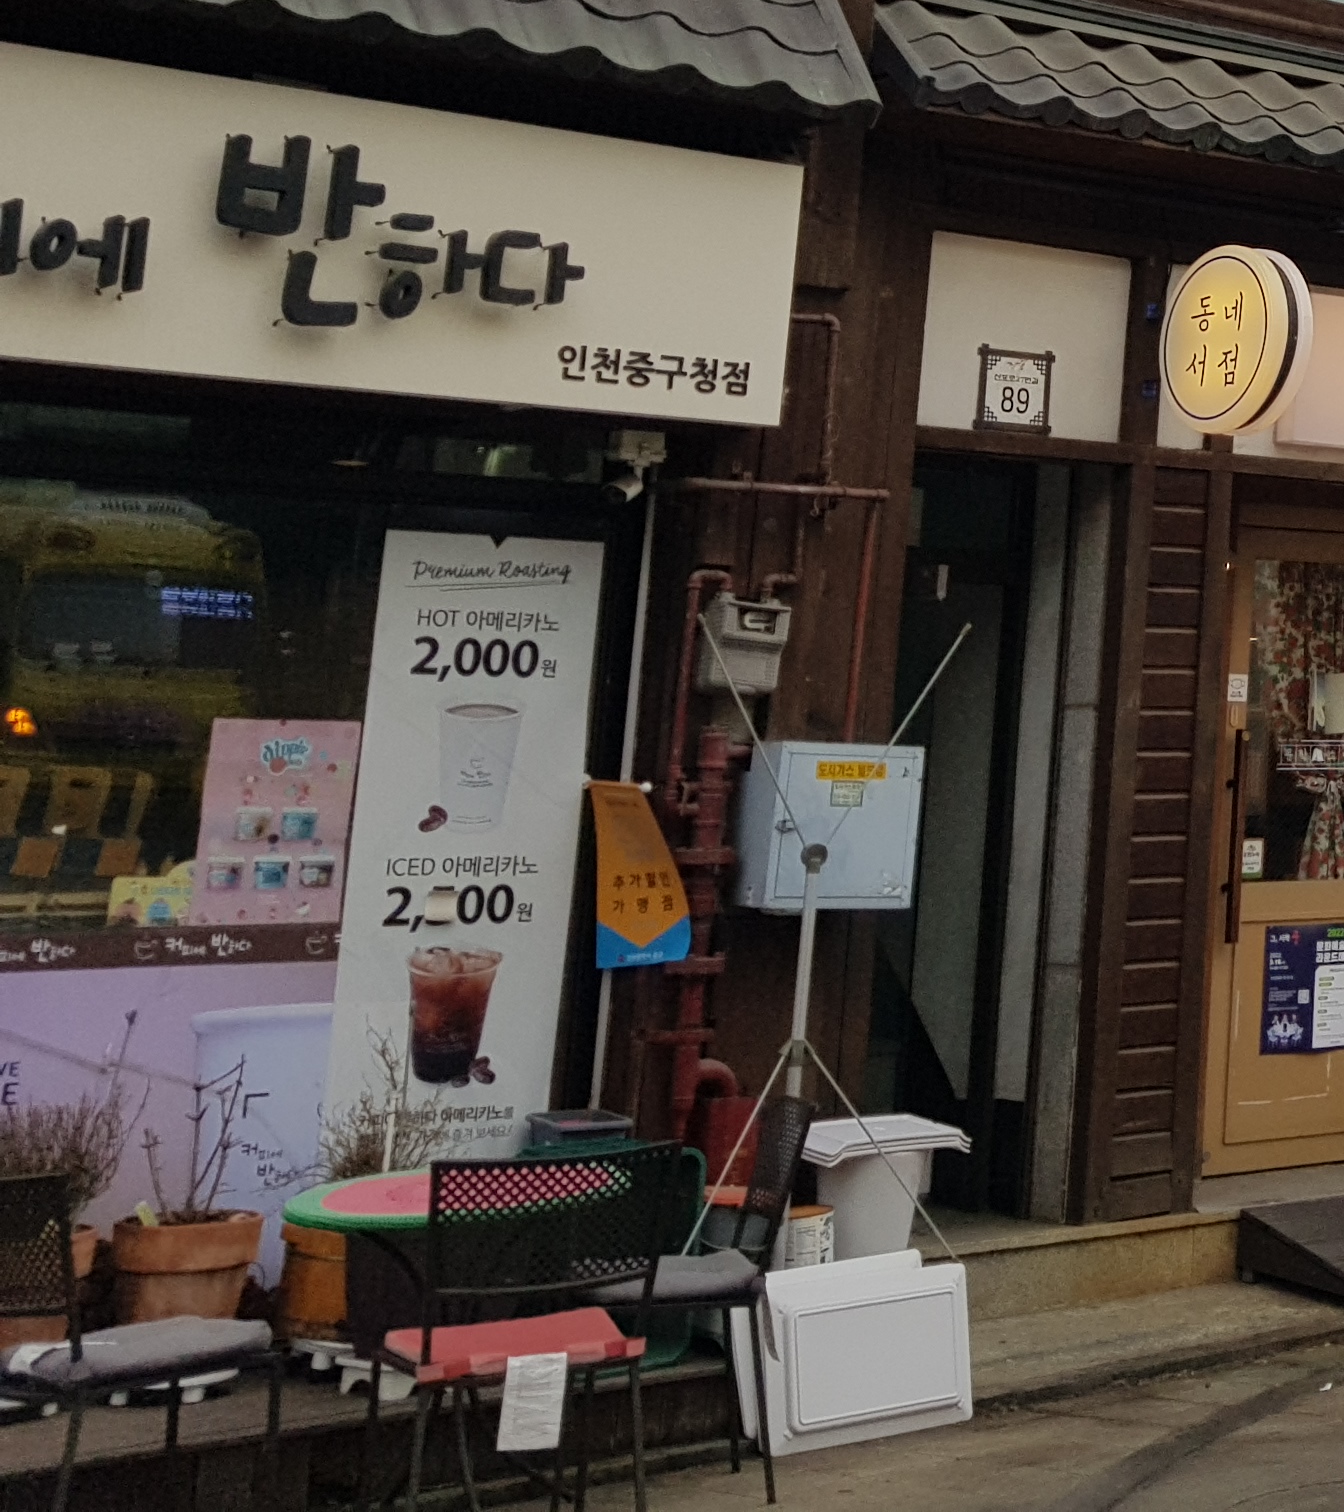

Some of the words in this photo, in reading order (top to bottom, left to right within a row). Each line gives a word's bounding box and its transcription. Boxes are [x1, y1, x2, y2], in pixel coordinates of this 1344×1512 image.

[215, 133, 586, 327] 반하다
[1190, 290, 1244, 333] 동네
[557, 344, 751, 397] 인천중구청점
[1185, 342, 1239, 387] 서점
[1001, 386, 1030, 414] 89
[412, 560, 495, 581] Premium
[499, 559, 571, 584] Roasting
[416, 608, 461, 628] HOT
[466, 609, 560, 633] 아메리카노
[385, 857, 436, 877] ICED
[442, 855, 539, 878] 아메리카노
[612, 871, 671, 891] 추가할인
[382, 883, 533, 933] 2,00원
